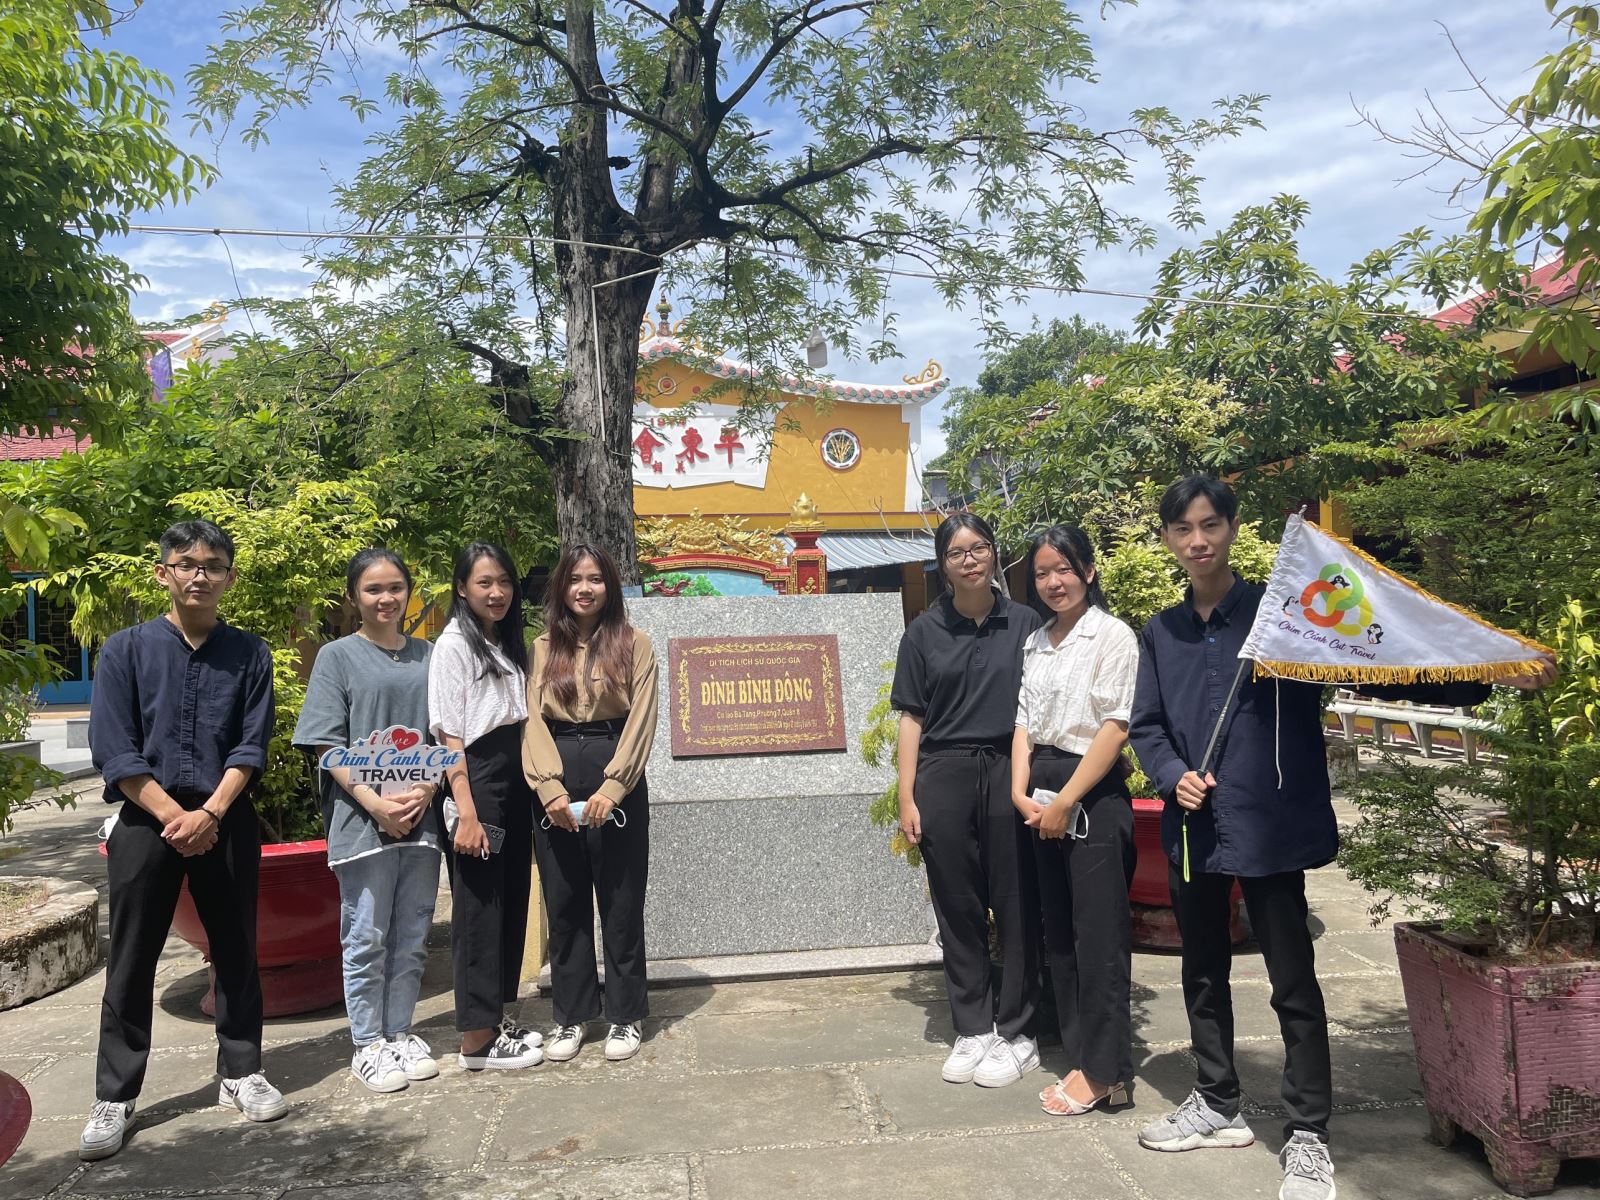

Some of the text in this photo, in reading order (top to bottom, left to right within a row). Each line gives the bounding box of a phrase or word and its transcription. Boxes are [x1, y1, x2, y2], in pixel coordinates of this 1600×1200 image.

[788, 656, 801, 664] GIA
[1349, 645, 1377, 661] Travel
[701, 674, 736, 706] ĐÌNH
[738, 672, 772, 704] BÌNH
[382, 732, 411, 746] love
[322, 748, 460, 768] Chim Cánh Cụt
[359, 768, 431, 782] TRAVEL
